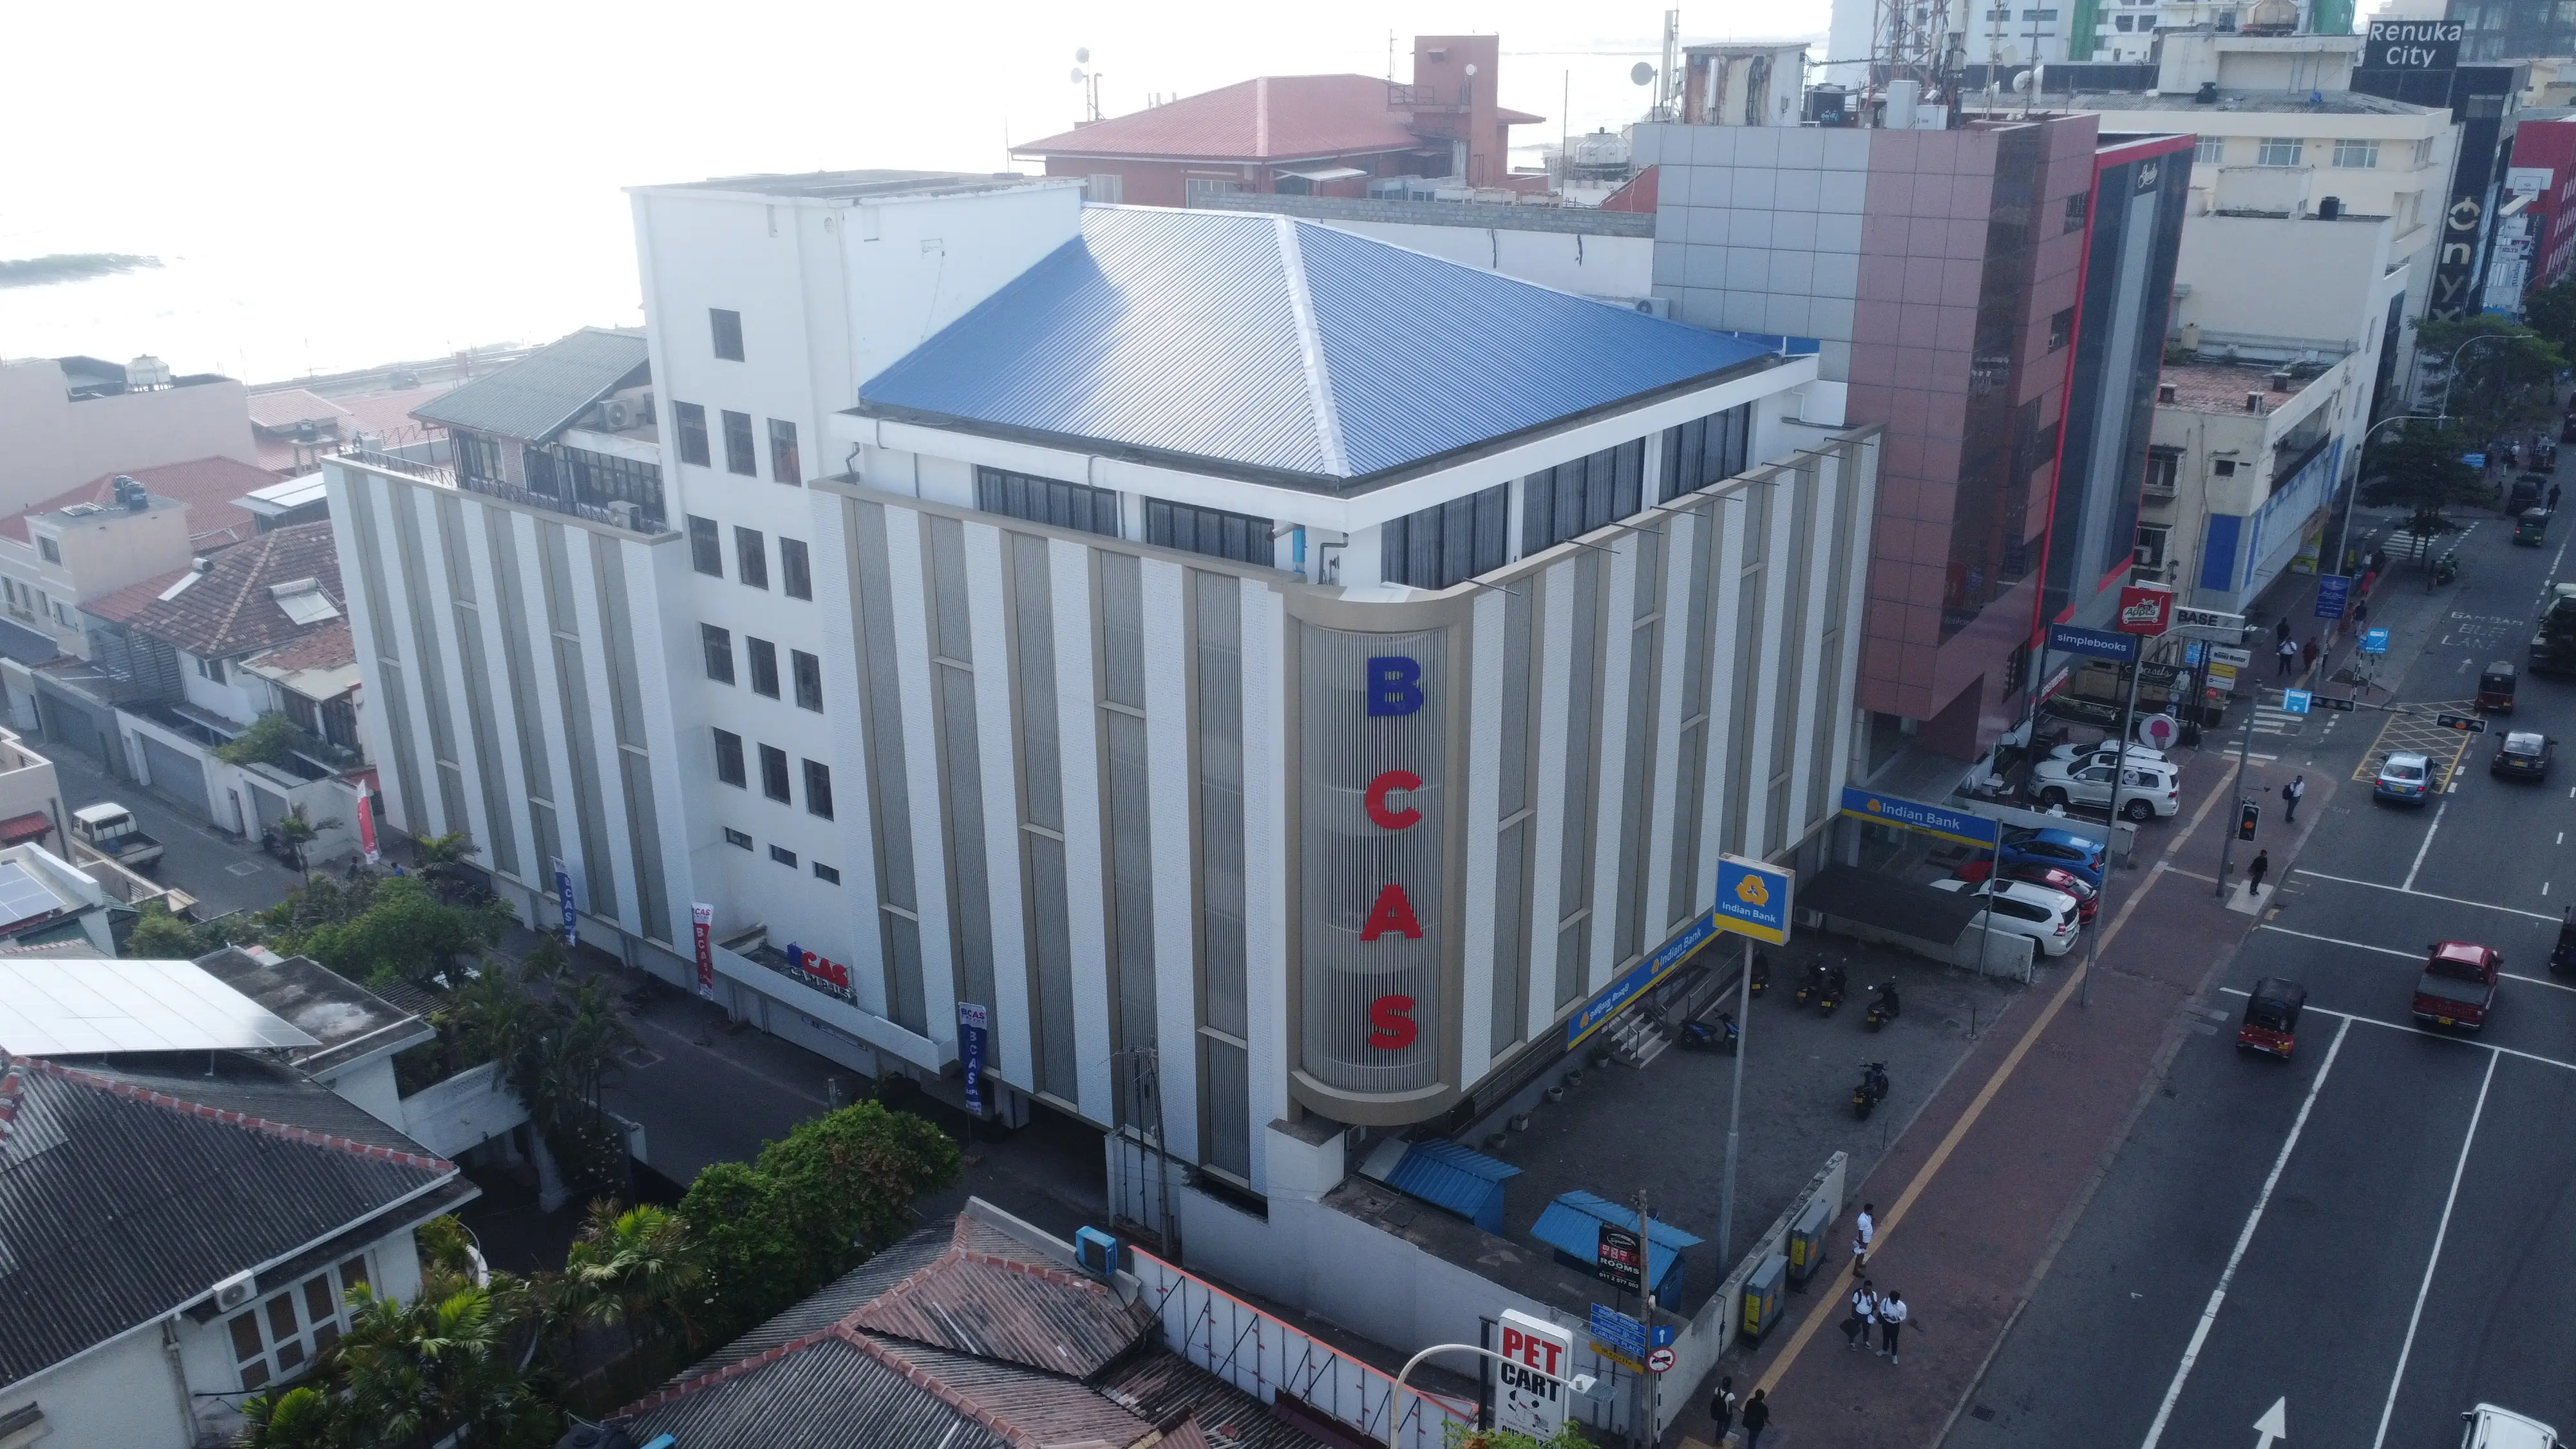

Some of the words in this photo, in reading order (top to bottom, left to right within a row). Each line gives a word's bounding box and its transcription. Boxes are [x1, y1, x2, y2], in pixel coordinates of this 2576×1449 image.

[2369, 23, 2462, 41] Renuka
[2386, 45, 2436, 68] City
[2177, 610, 2218, 627] BASE
[2057, 633, 2127, 652] simplebooks
[1882, 802, 1923, 822] Indian
[1926, 812, 1960, 830] Bank
[1360, 656, 1423, 1050] BCAS
[564, 876, 573, 922] BCAS
[692, 908, 711, 916] CAS
[1722, 901, 1751, 916] Indian
[1752, 909, 1776, 923] Bank
[1660, 943, 1683, 967] Indian
[1683, 927, 1702, 949] Bank
[961, 1008, 985, 1019] BCAS
[967, 1030, 978, 1084] BCAS
[1600, 1257, 1640, 1275] ROOMS
[1502, 1326, 1562, 1376] PET
[1594, 1328, 1620, 1345] CARLWIL
[1621, 1340, 1641, 1354] PLACE
[1501, 1361, 1560, 1403] CART
